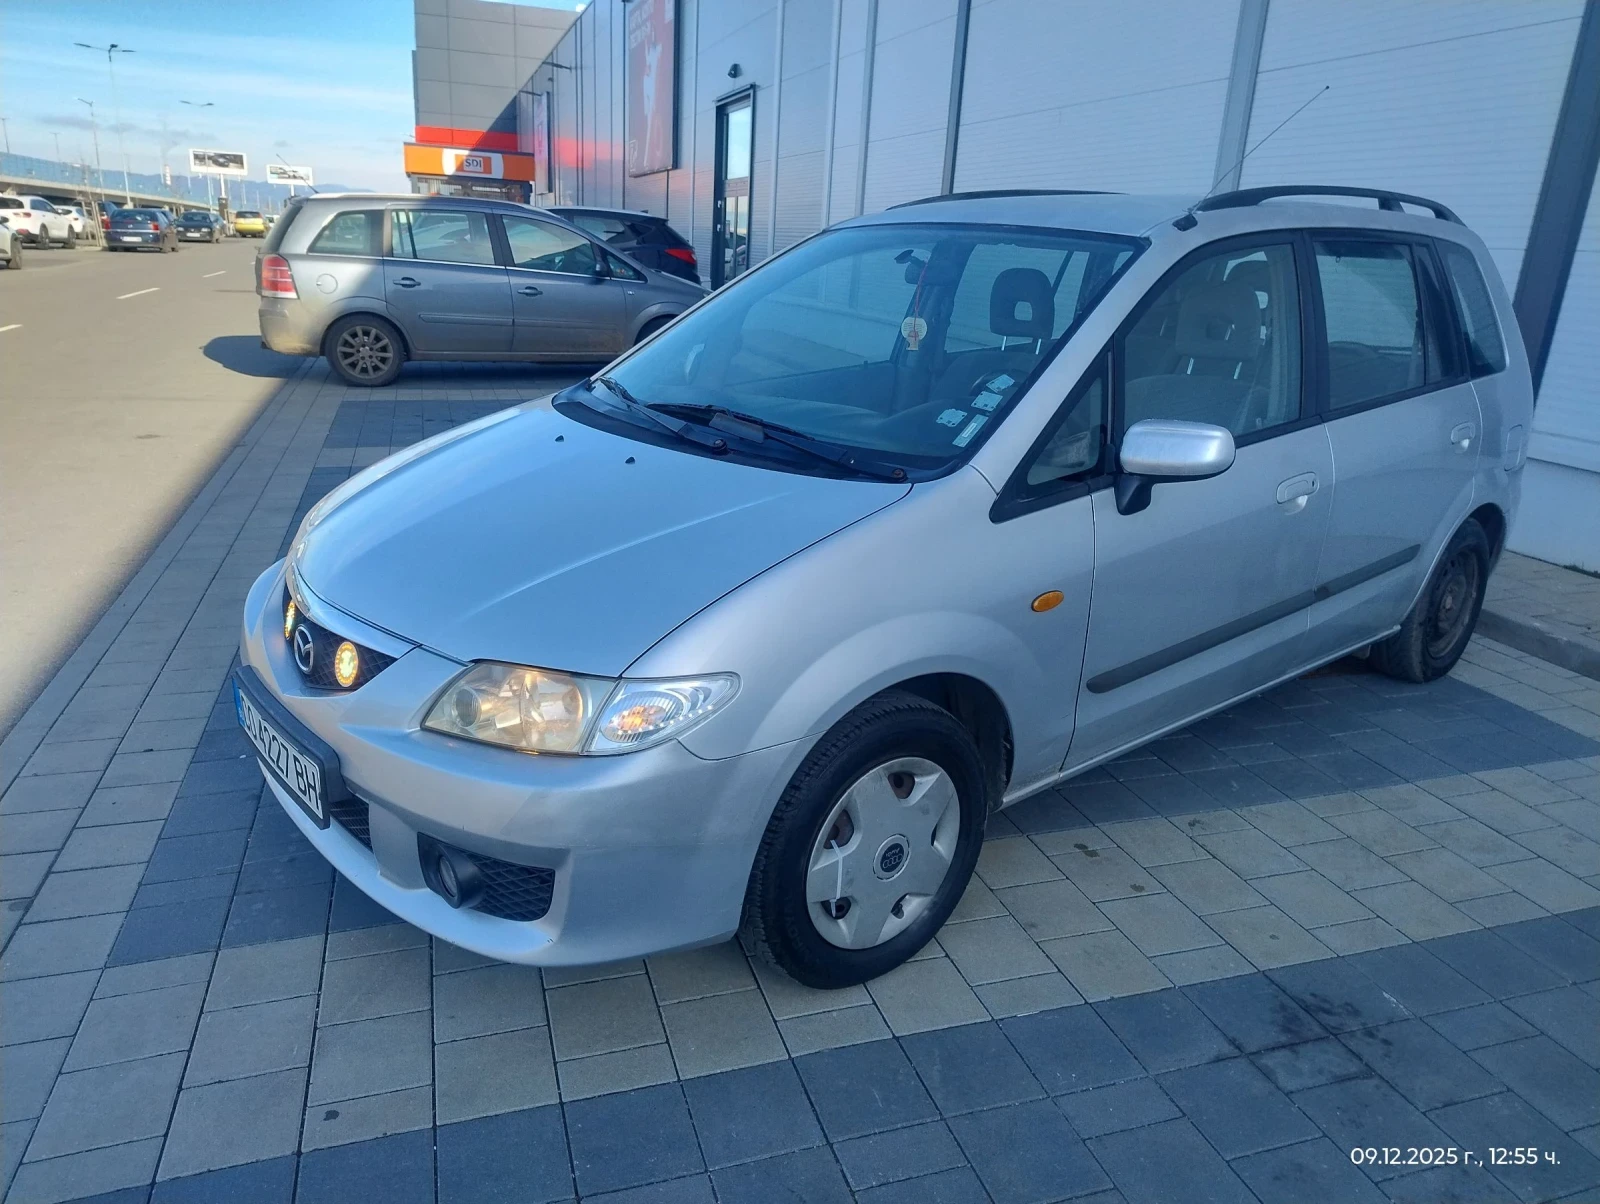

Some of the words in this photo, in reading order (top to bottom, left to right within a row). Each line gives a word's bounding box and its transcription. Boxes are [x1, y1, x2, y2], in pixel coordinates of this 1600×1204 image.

[465, 158, 482, 168] SDI
[258, 718, 289, 778] 4227
[293, 753, 319, 812] BH
